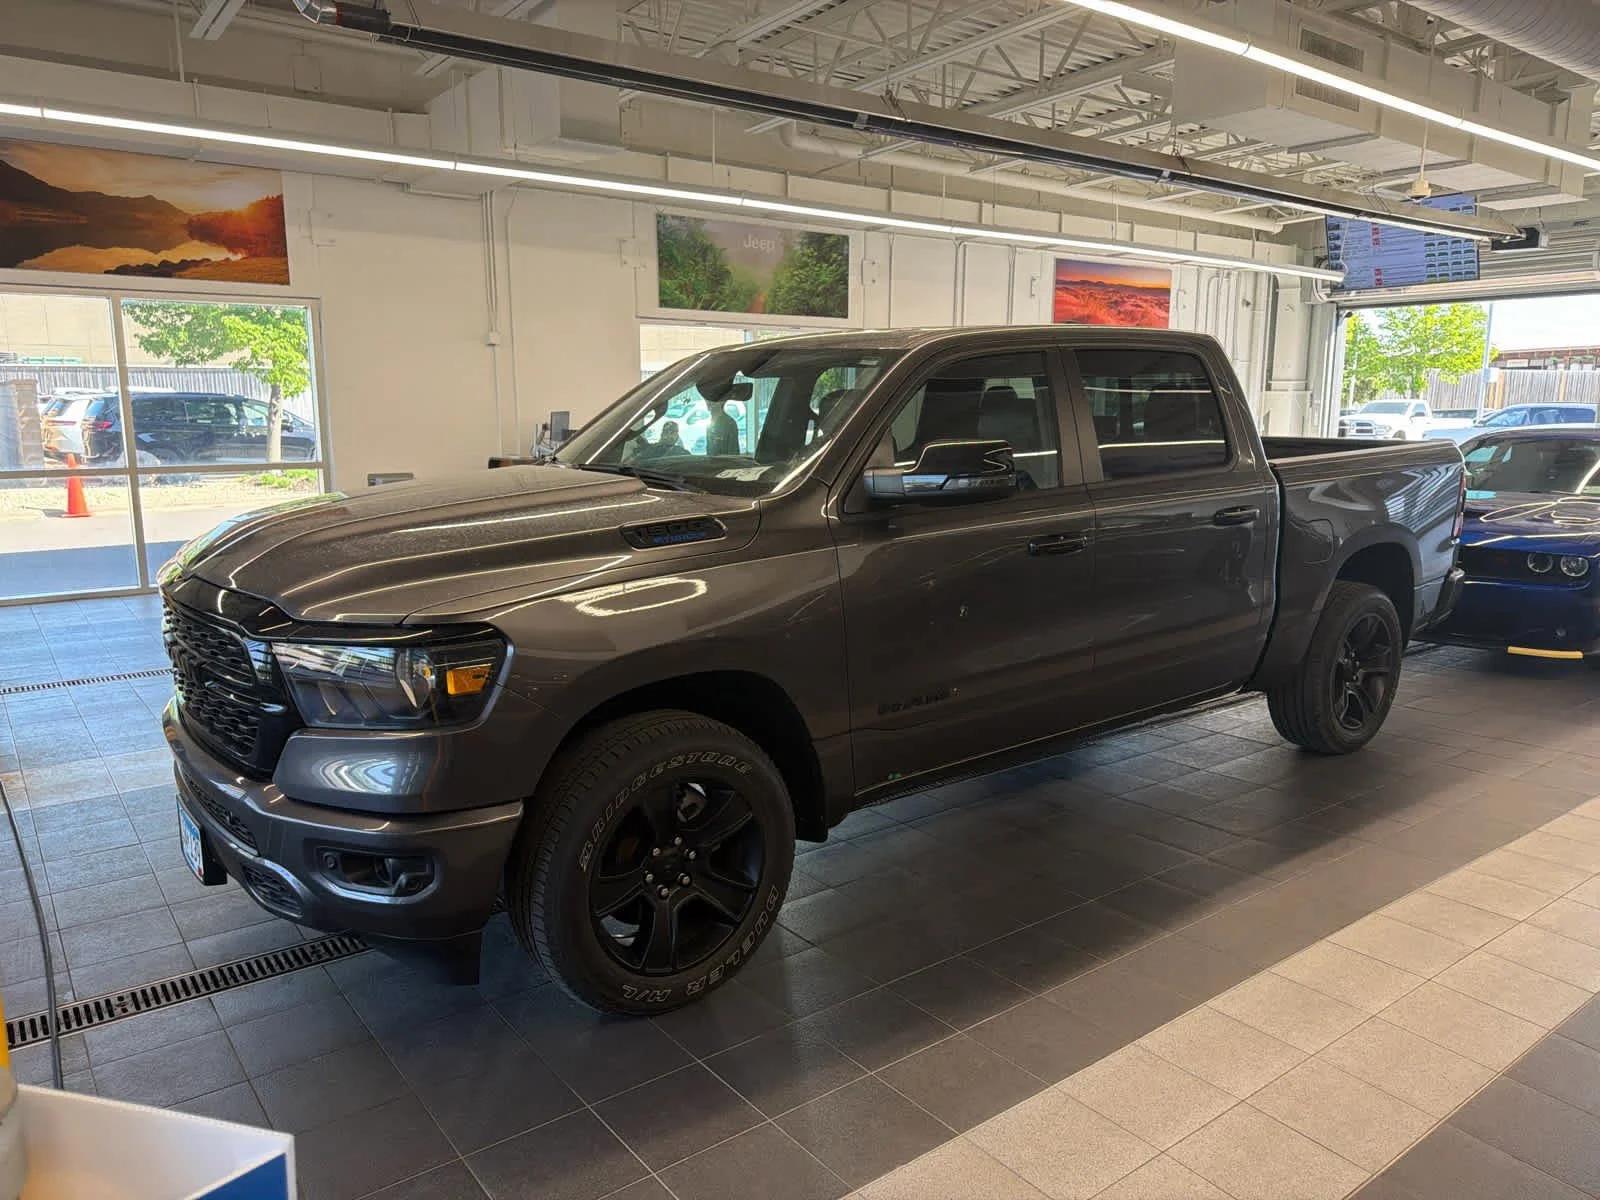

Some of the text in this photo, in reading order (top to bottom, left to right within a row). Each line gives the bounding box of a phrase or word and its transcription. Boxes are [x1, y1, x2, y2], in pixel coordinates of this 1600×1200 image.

[743, 234, 777, 254] Jeep
[578, 751, 753, 872] BRIDGESTONE
[686, 885, 780, 997] DUELER
